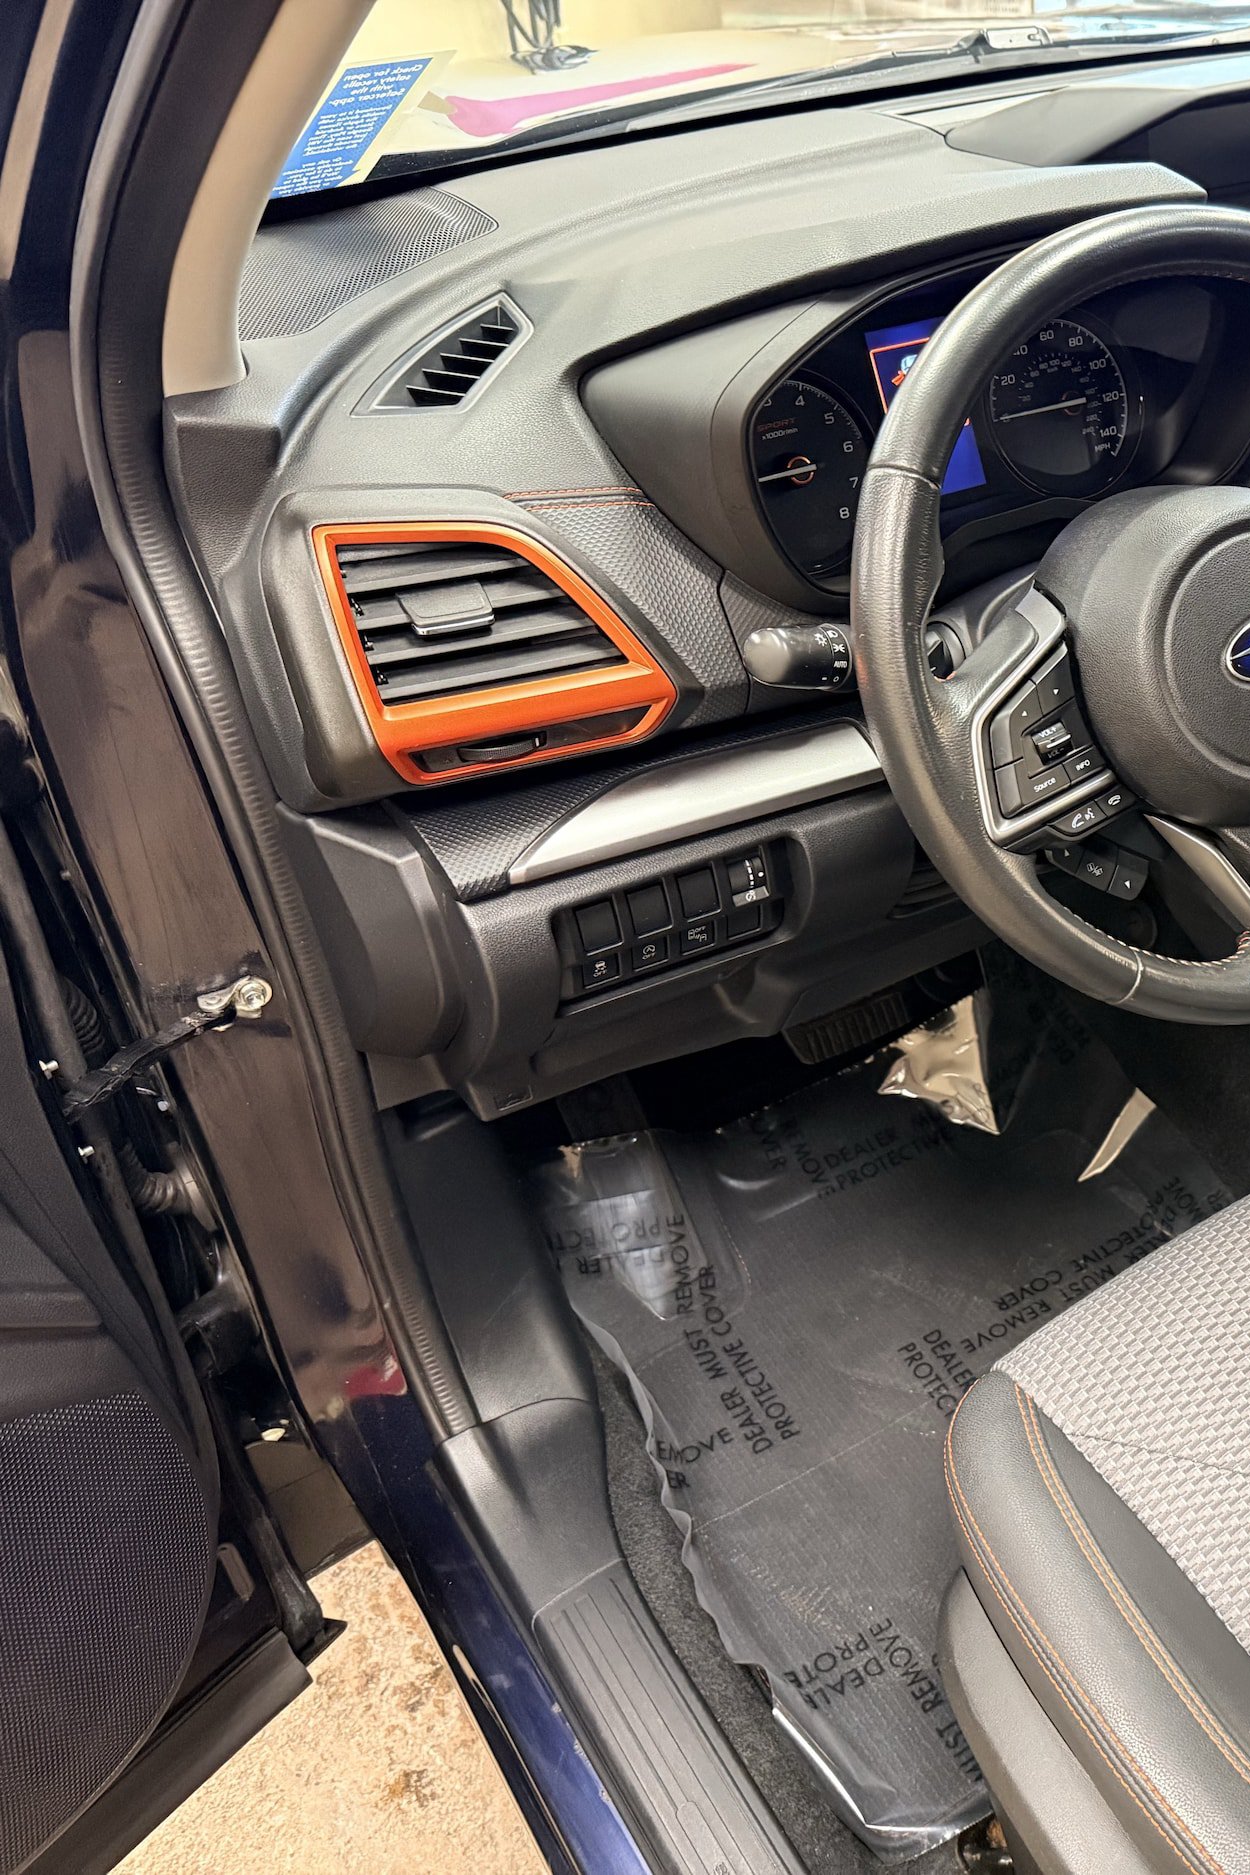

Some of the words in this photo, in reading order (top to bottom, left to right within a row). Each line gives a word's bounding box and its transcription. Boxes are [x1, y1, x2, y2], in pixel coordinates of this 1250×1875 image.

[1040, 330, 1054, 341] 60
[1068, 335, 1083, 347] 80
[1089, 359, 1106, 370] 100
[1000, 374, 1015, 386] 20
[795, 395, 805, 407] 4
[1102, 391, 1119, 402] 120
[824, 412, 834, 424] 5
[1100, 426, 1117, 437] 140
[843, 441, 853, 452] 6
[1094, 442, 1111, 453] MPH
[849, 477, 858, 488] 7
[840, 507, 850, 519] 8
[1075, 760, 1091, 771] INFO
[1034, 777, 1057, 792] Source
[823, 1126, 899, 1170] DEALER
[666, 1213, 694, 1315] REMOVE
[994, 1269, 1063, 1311] COVER
[1059, 1264, 1116, 1303] MUST
[699, 1264, 732, 1336] COVER
[960, 1299, 1052, 1354] REMOVE
[683, 1328, 728, 1381] MUST
[897, 1342, 957, 1418] PROTEC
[721, 1338, 801, 1440] PROTECTIVE
[720, 1386, 774, 1454] DEALER
[656, 1427, 735, 1464] EMOVE
[783, 1632, 870, 1690] PROTE
[869, 1617, 943, 1714] REMOVE
